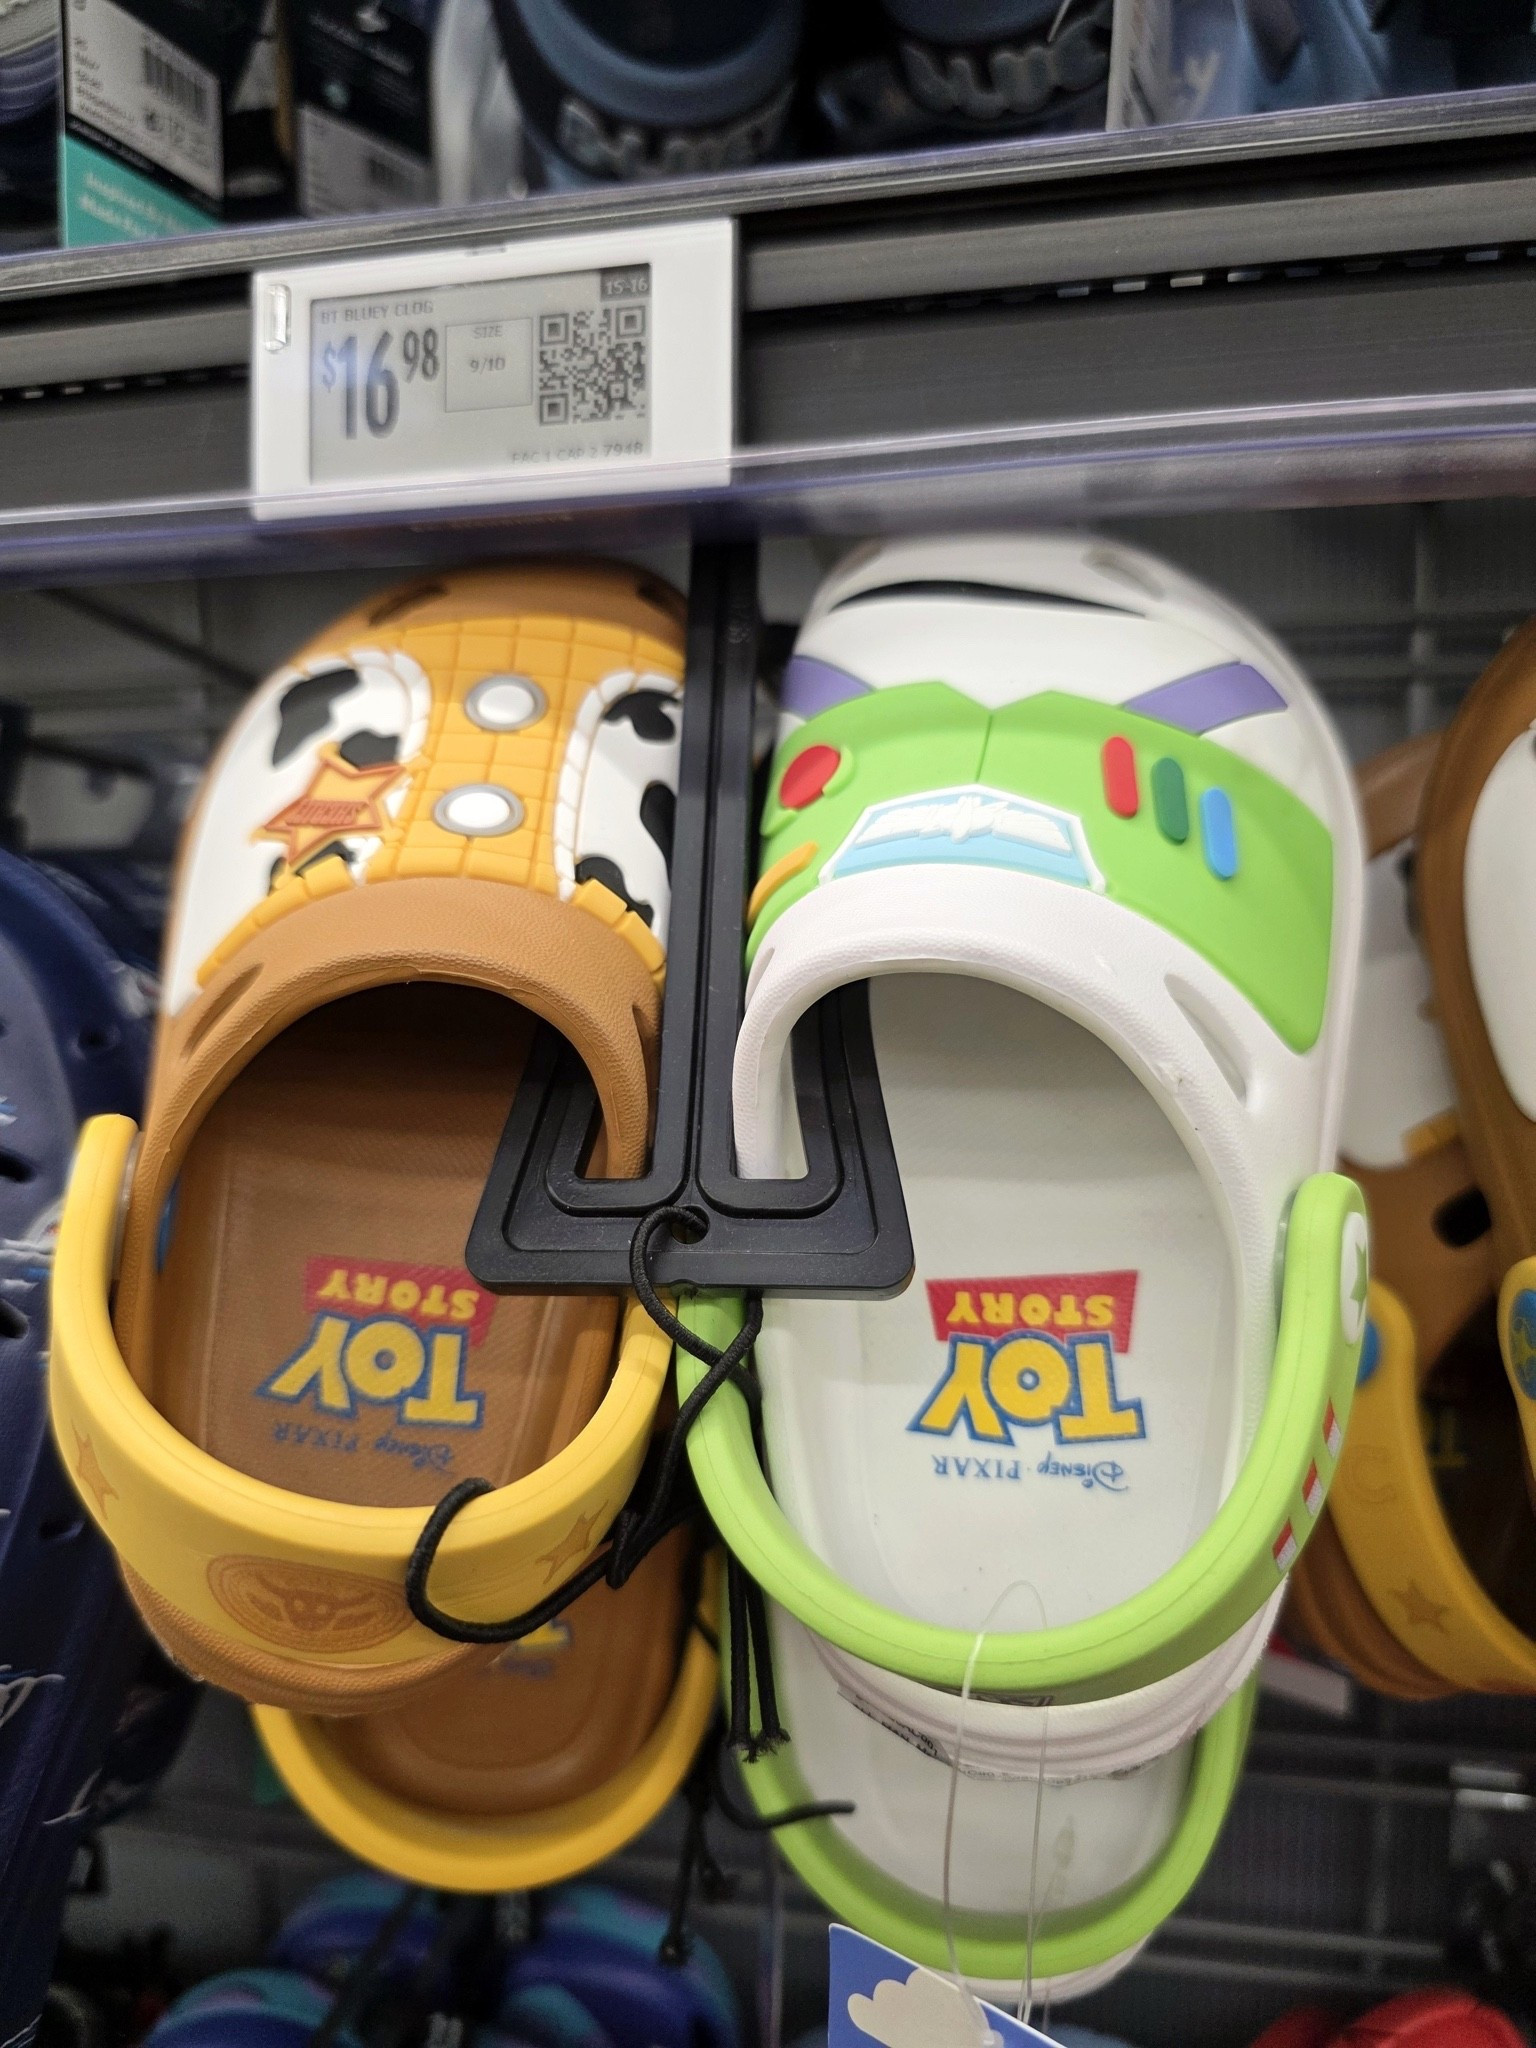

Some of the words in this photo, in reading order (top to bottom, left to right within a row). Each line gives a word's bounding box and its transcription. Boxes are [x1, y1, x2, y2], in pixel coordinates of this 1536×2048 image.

[605, 277, 649, 297] 15-16
[344, 305, 390, 323] BLUEY
[472, 324, 504, 340] SIZE
[469, 354, 506, 376] 9/10
[602, 441, 644, 459] 7948
[317, 1268, 480, 1321] STORY
[946, 1291, 1116, 1328] STORY
[258, 1311, 484, 1431] TOY
[907, 1330, 1145, 1446] TOY
[271, 1422, 359, 1452] PIXAR
[931, 1454, 1022, 1481] PIXAR
